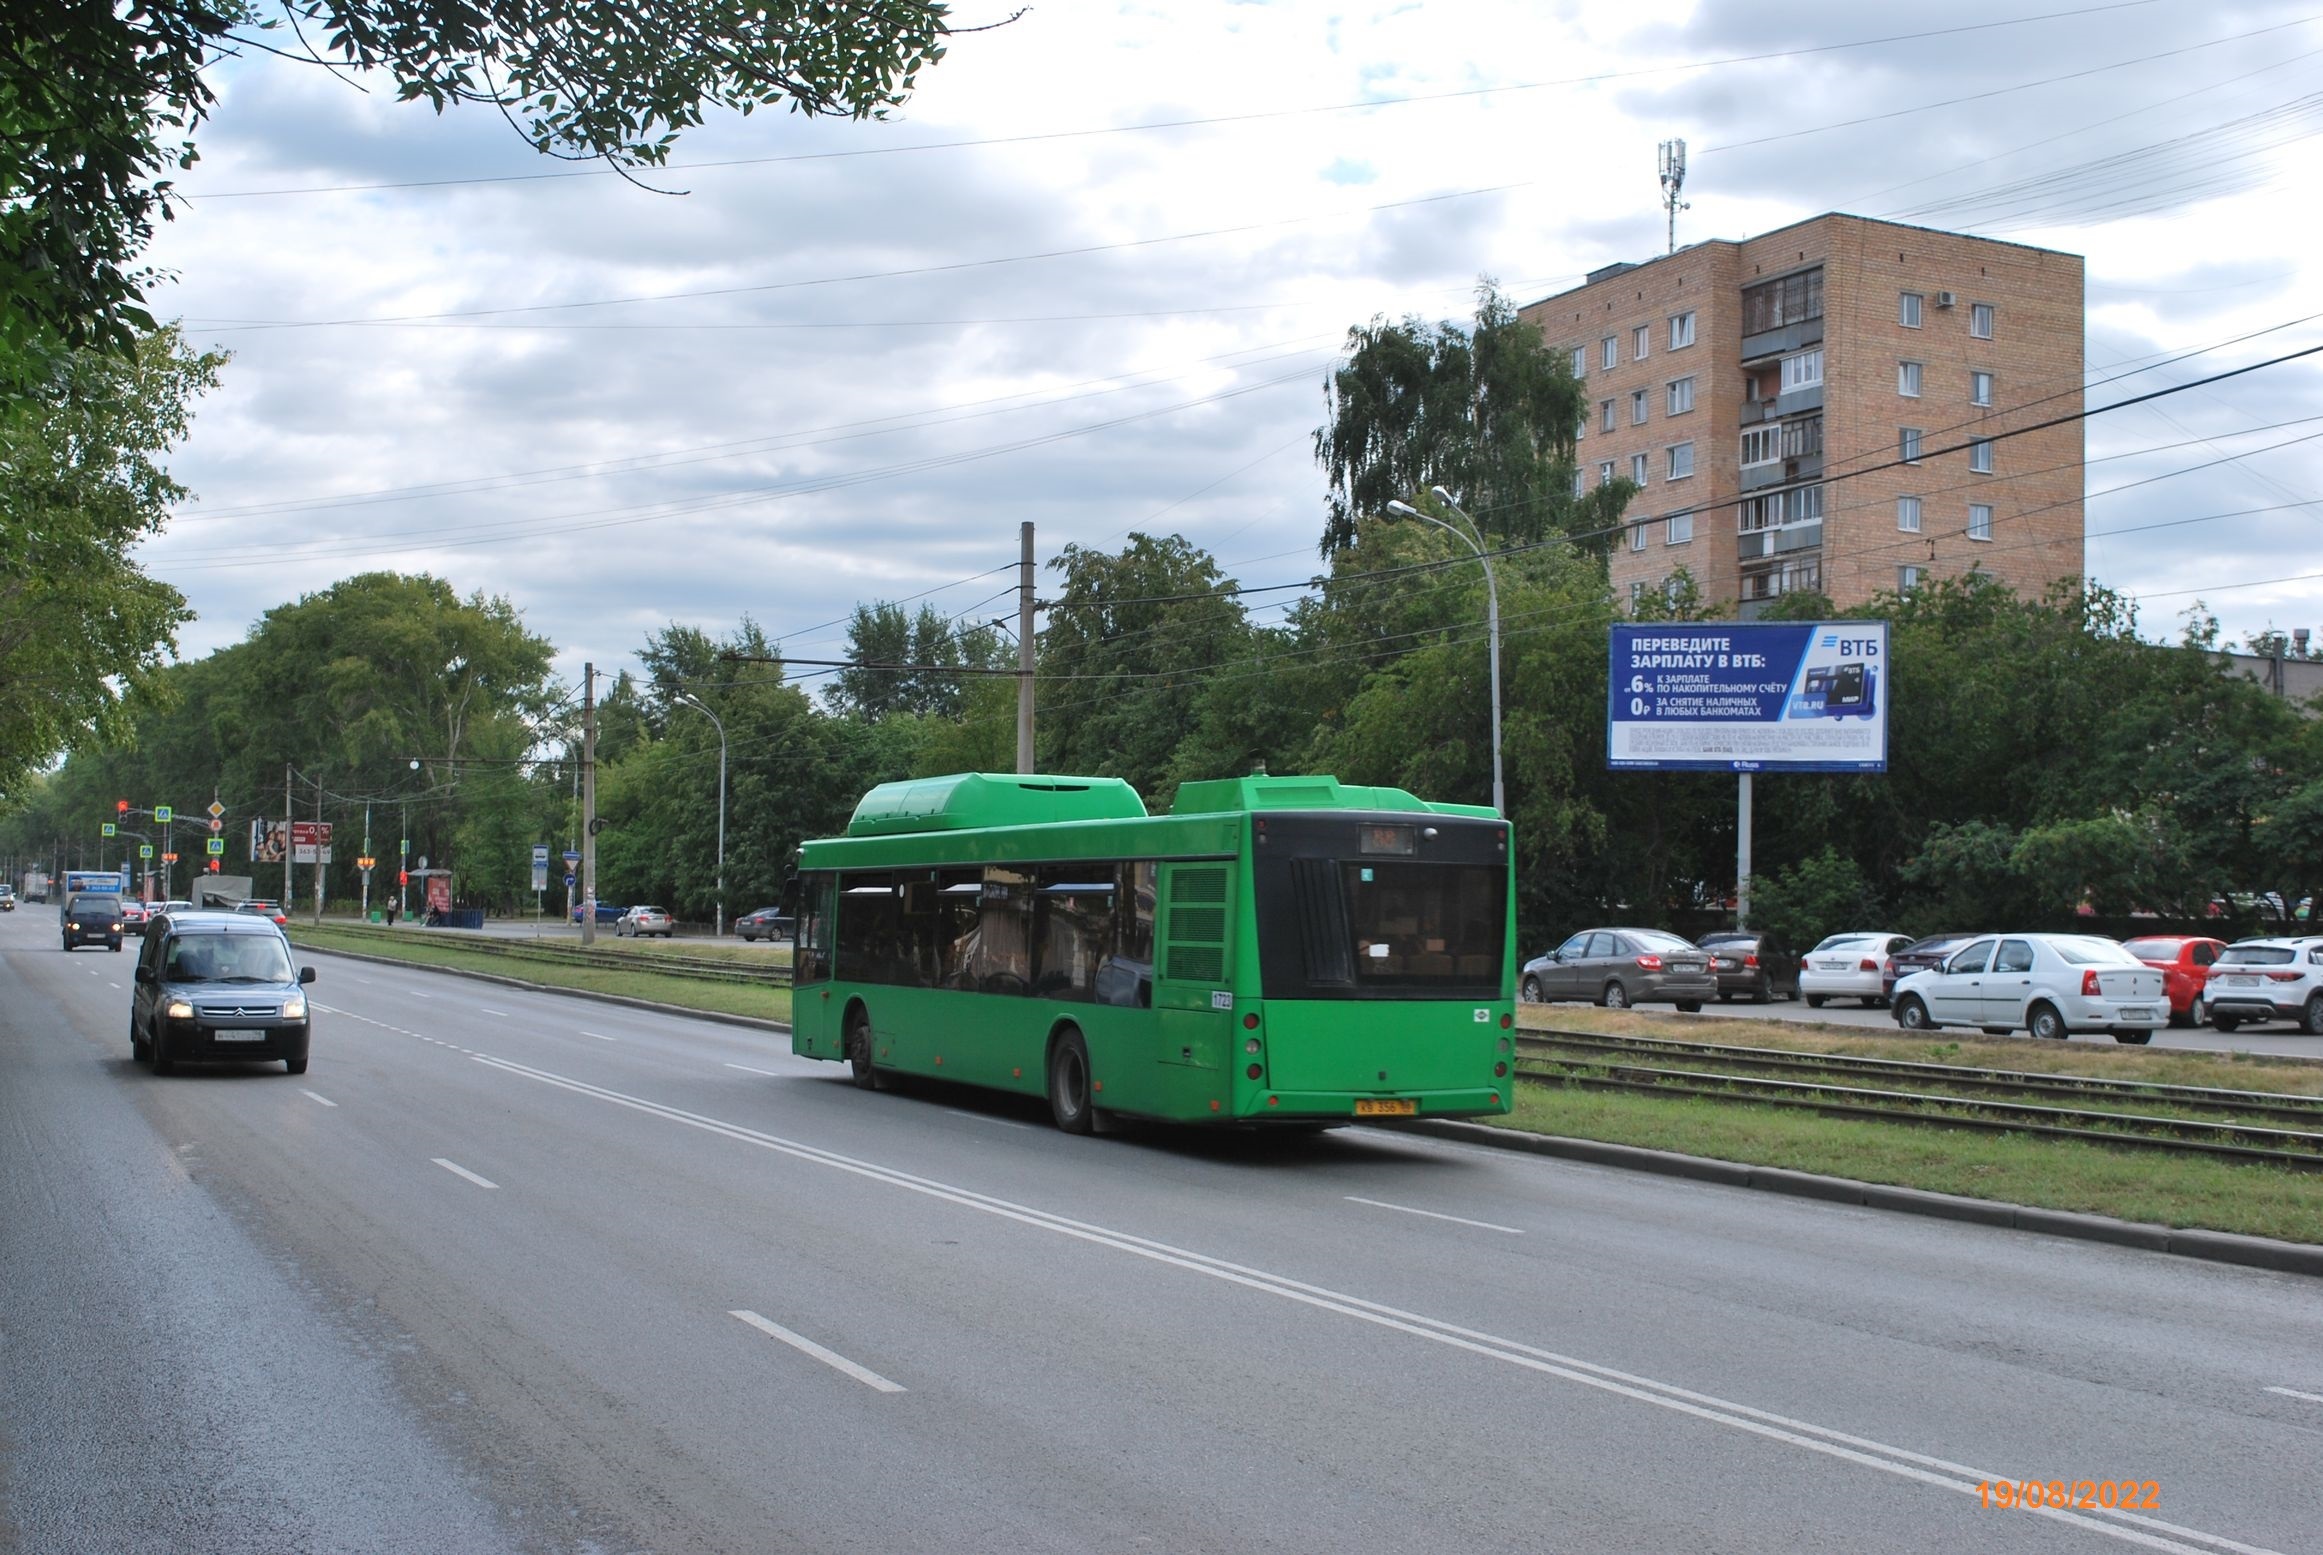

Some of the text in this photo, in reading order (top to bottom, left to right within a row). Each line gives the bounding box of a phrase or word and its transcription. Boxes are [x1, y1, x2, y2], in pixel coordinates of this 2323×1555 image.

[1631, 638, 1730, 653] ПЕРЕВЕДИТЕ
[1840, 640, 1878, 656] ВТБ
[1631, 655, 1766, 668] ЗАРПЛАТУ В ВТБ:
[1631, 675, 1654, 693] 6%
[1657, 675, 1710, 684] К ЗАРПЛАТЕ
[1657, 682, 1787, 693] ПО НАКОПИТЕЛЬНОМУ СЧЁТУ
[1656, 697, 1757, 706] ЗА СНЯТИЕ НАЛИЧНЫХ
[1656, 707, 1761, 716] В ЛЮБЫХ БАНКОМАТАХ
[1214, 993, 1231, 1008] 1723
